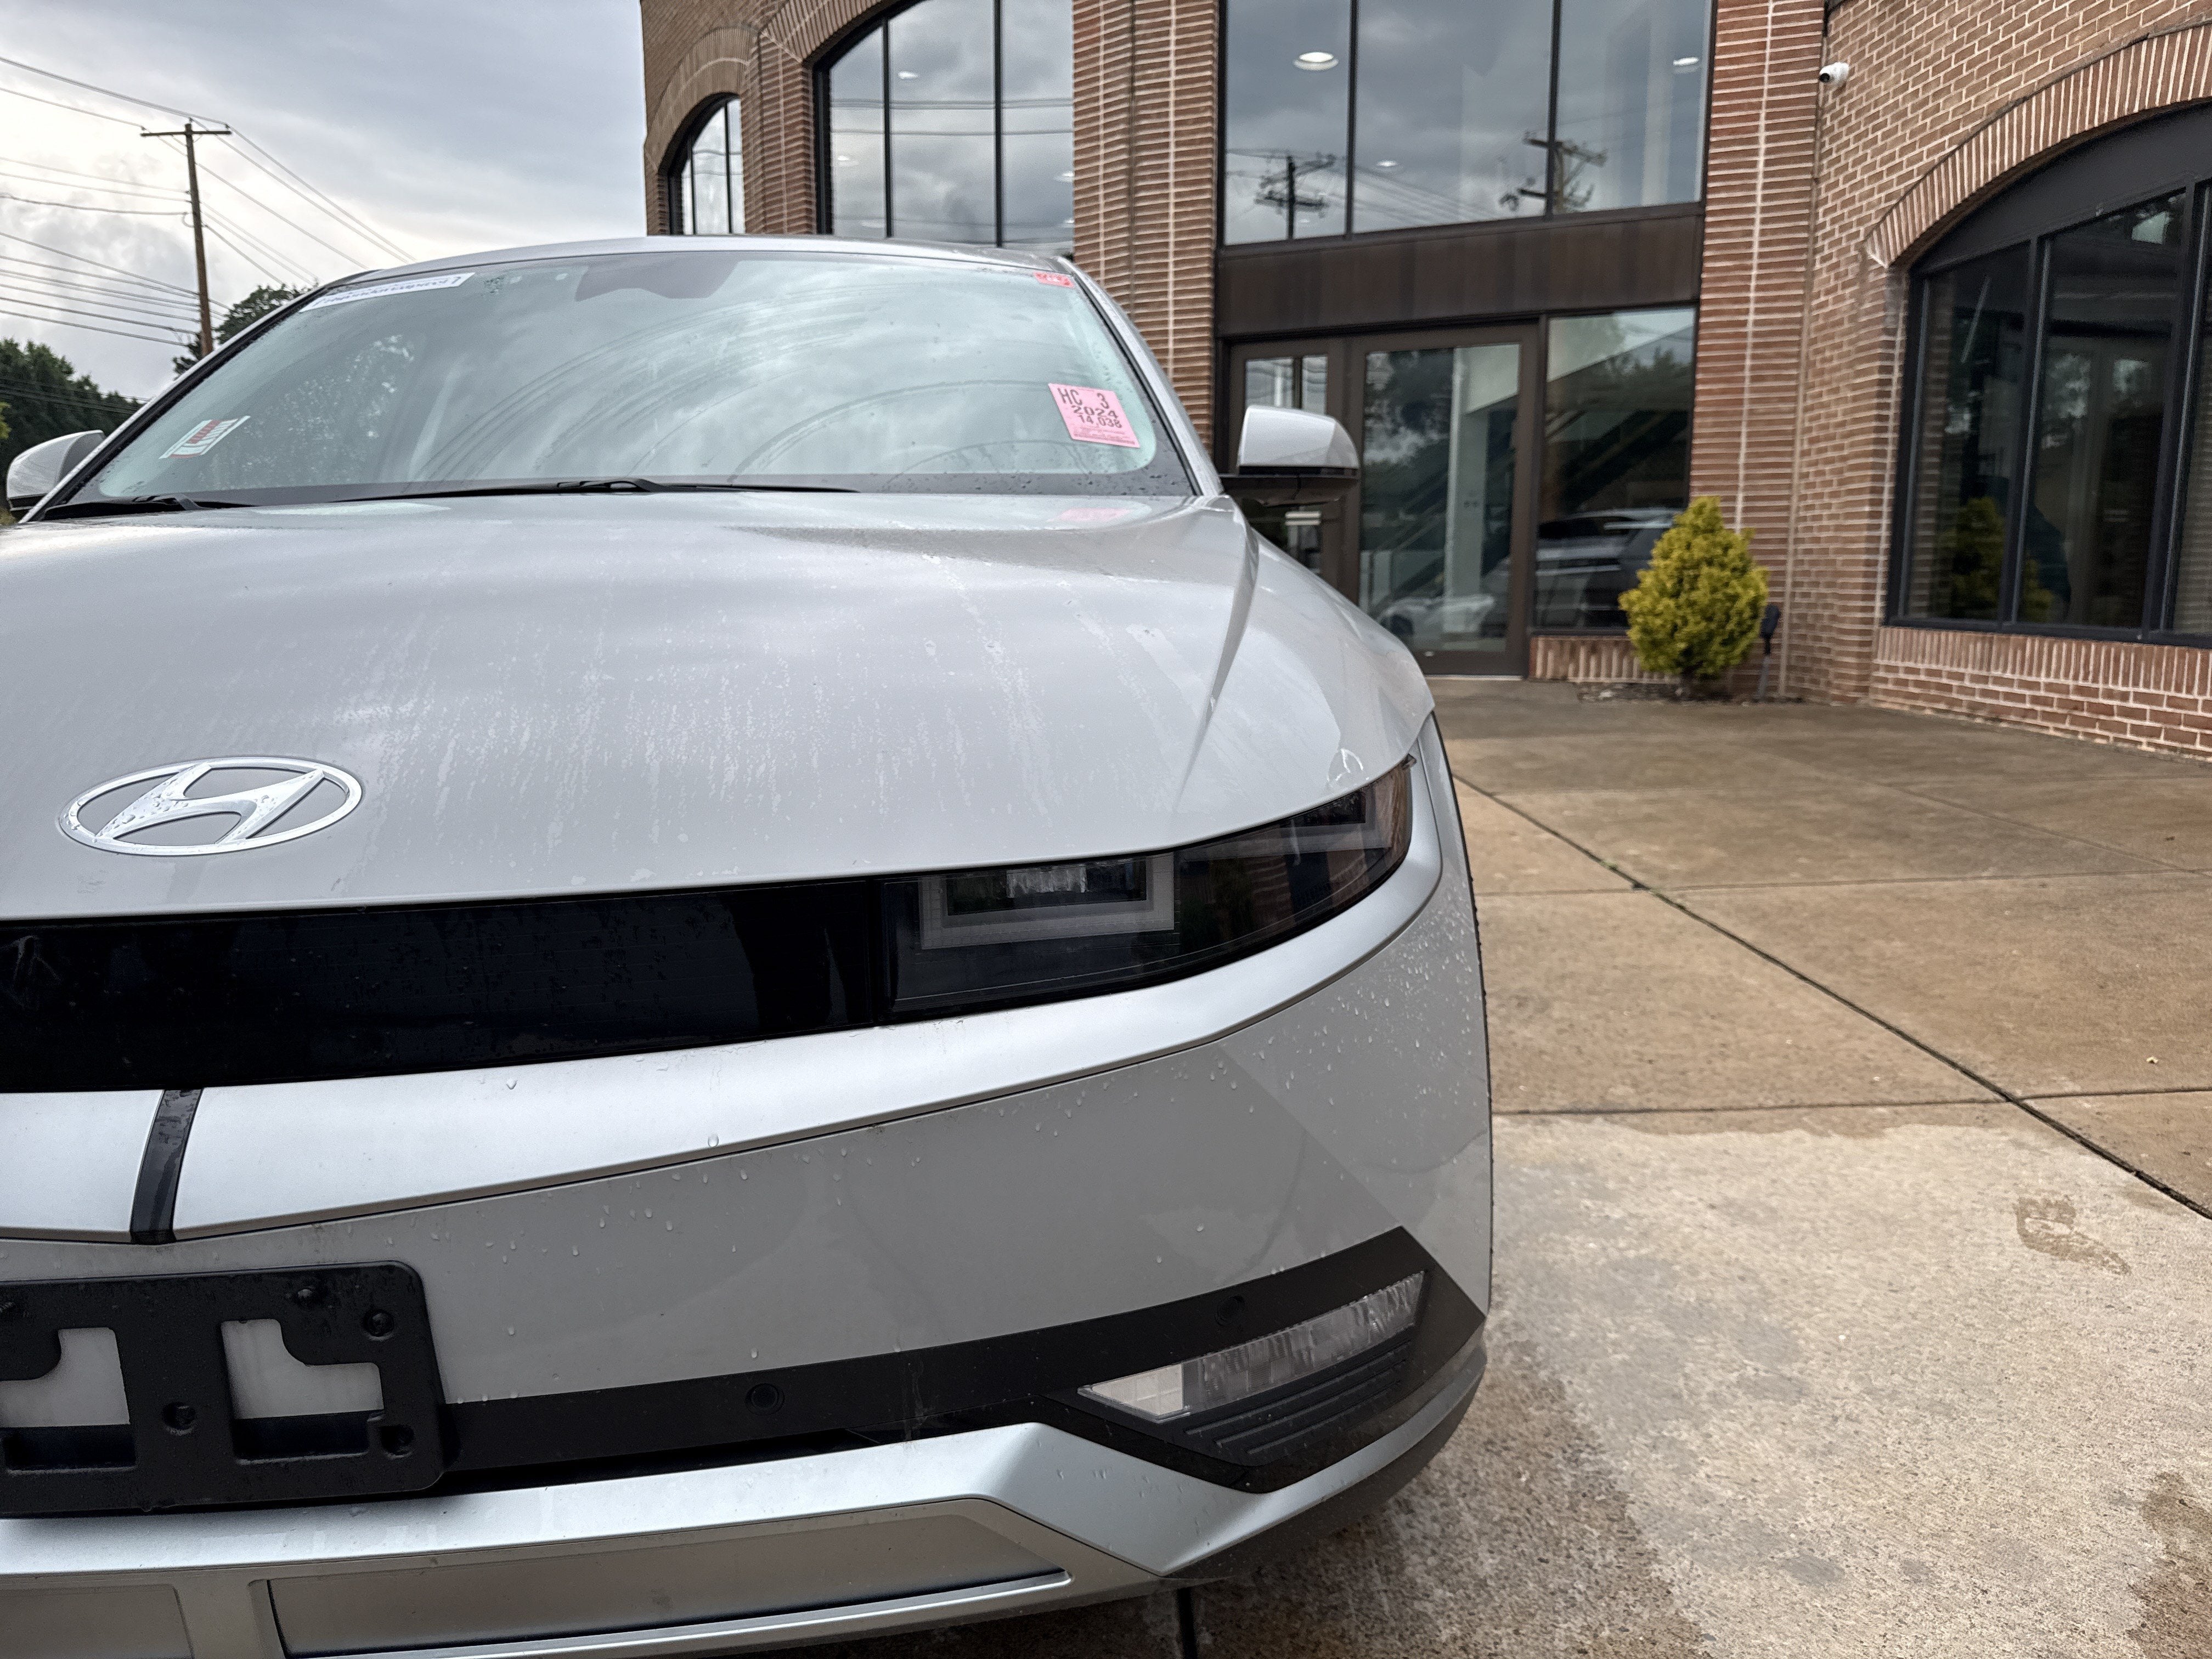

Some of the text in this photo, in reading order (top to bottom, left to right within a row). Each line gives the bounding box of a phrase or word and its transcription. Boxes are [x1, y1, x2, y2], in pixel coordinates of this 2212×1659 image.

[1057, 387, 1110, 409] HC 3
[1071, 405, 1118, 419] 2024
